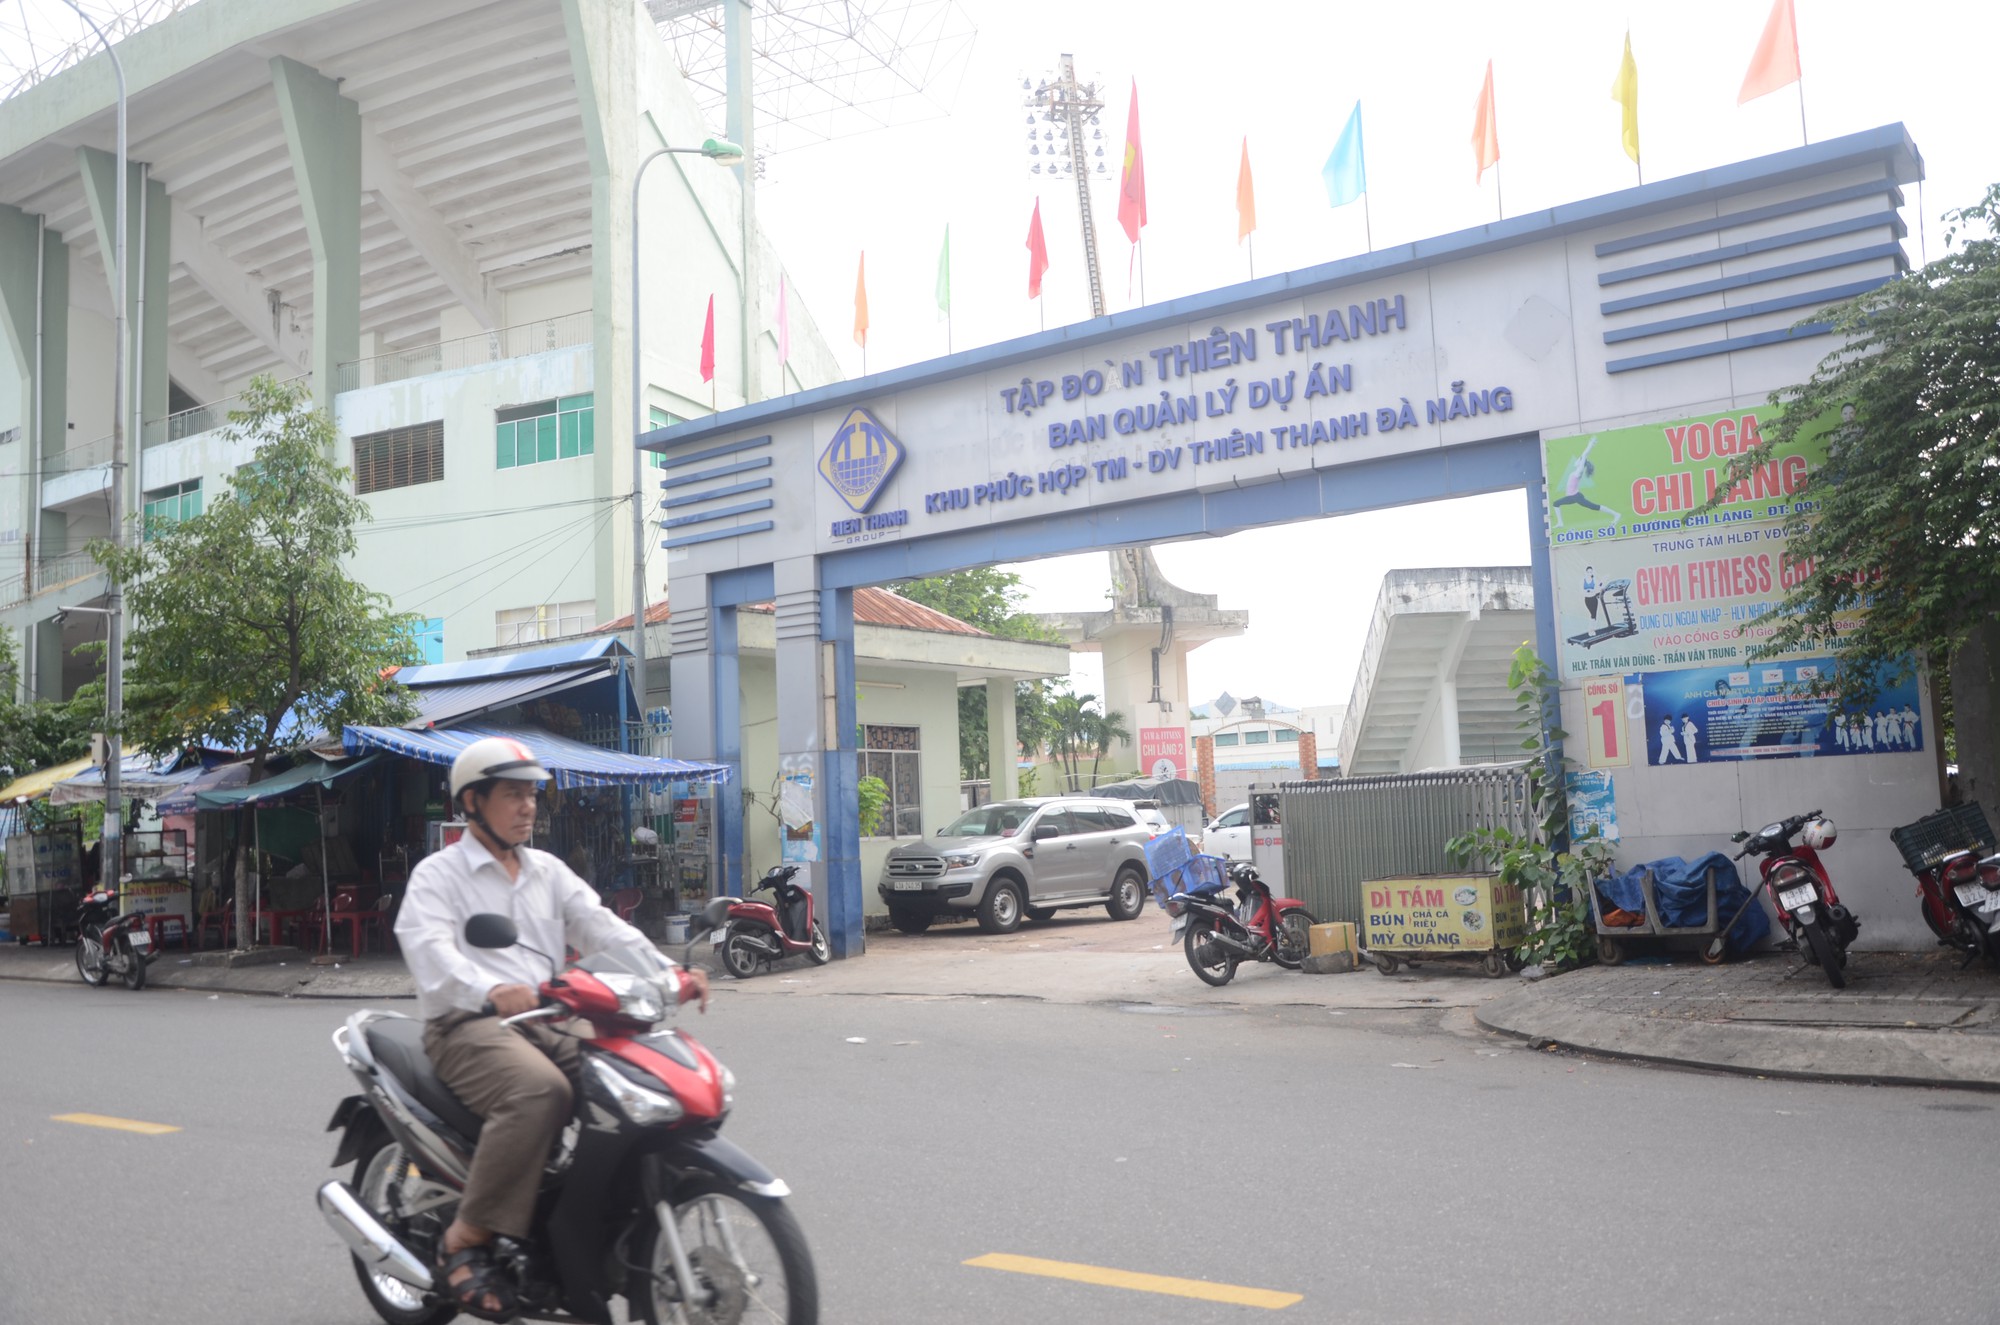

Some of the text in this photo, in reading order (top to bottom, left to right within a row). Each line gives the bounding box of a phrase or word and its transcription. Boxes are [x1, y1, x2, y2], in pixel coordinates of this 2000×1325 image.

[1000, 294, 1406, 416] TẬP ĐOÀN THIÊN THANH
[1048, 362, 1352, 449] BAN QUẢN LÝ DỰ ÁN
[925, 487, 969, 514] KHU
[974, 472, 1033, 505] PHỨC
[1038, 464, 1087, 495] HỢP
[1092, 457, 1127, 482] TM
[1148, 447, 1182, 473] DV
[1188, 428, 1263, 464] THIÊN
[1271, 412, 1368, 450] THANH
[1376, 398, 1418, 433] ĐÀ
[1426, 380, 1514, 424] NẴNG
[1664, 415, 1763, 464] YOGA
[1631, 471, 1694, 515] CHI
[863, 509, 908, 531] THANH
[1620, 526, 1627, 535] 1
[1632, 518, 1681, 534] ĐƯỜNG
[1685, 516, 1709, 528] CHI
[1714, 509, 1753, 523] LĂNG
[1767, 504, 1790, 517] ĐT:
[847, 531, 885, 544] GROUP
[1652, 540, 1694, 553] TRUNG
[1697, 535, 1723, 547] TÂM
[1728, 530, 1760, 544] HLĐT
[1764, 527, 1789, 540] VĐV
[1636, 564, 1681, 606] GYM
[1687, 553, 1772, 600] FITNESS
[1731, 605, 1746, 621] HLV
[1653, 634, 1681, 648] (VÀO
[1685, 627, 1719, 643] CỔNG
[1744, 628, 1754, 639] 1)
[1572, 661, 1588, 672] HLV:
[1590, 656, 1611, 670] TRẦN
[1613, 655, 1630, 668] VĂN
[1632, 654, 1655, 667] DŨNG
[1663, 650, 1686, 664] TRẦN
[1687, 649, 1705, 663] VĂN
[1707, 646, 1736, 660] TRUNG
[1608, 681, 1618, 694] SỐ
[1592, 700, 1618, 758] 1
[1142, 741, 1184, 756] CHI LĂNG 2
[1370, 885, 1445, 908] DÌ TẤM
[1370, 912, 1404, 926] BÚN
[1412, 909, 1432, 918] CHẢ
[1372, 930, 1395, 945] MỲ
[1402, 928, 1460, 945] QUẢNG
